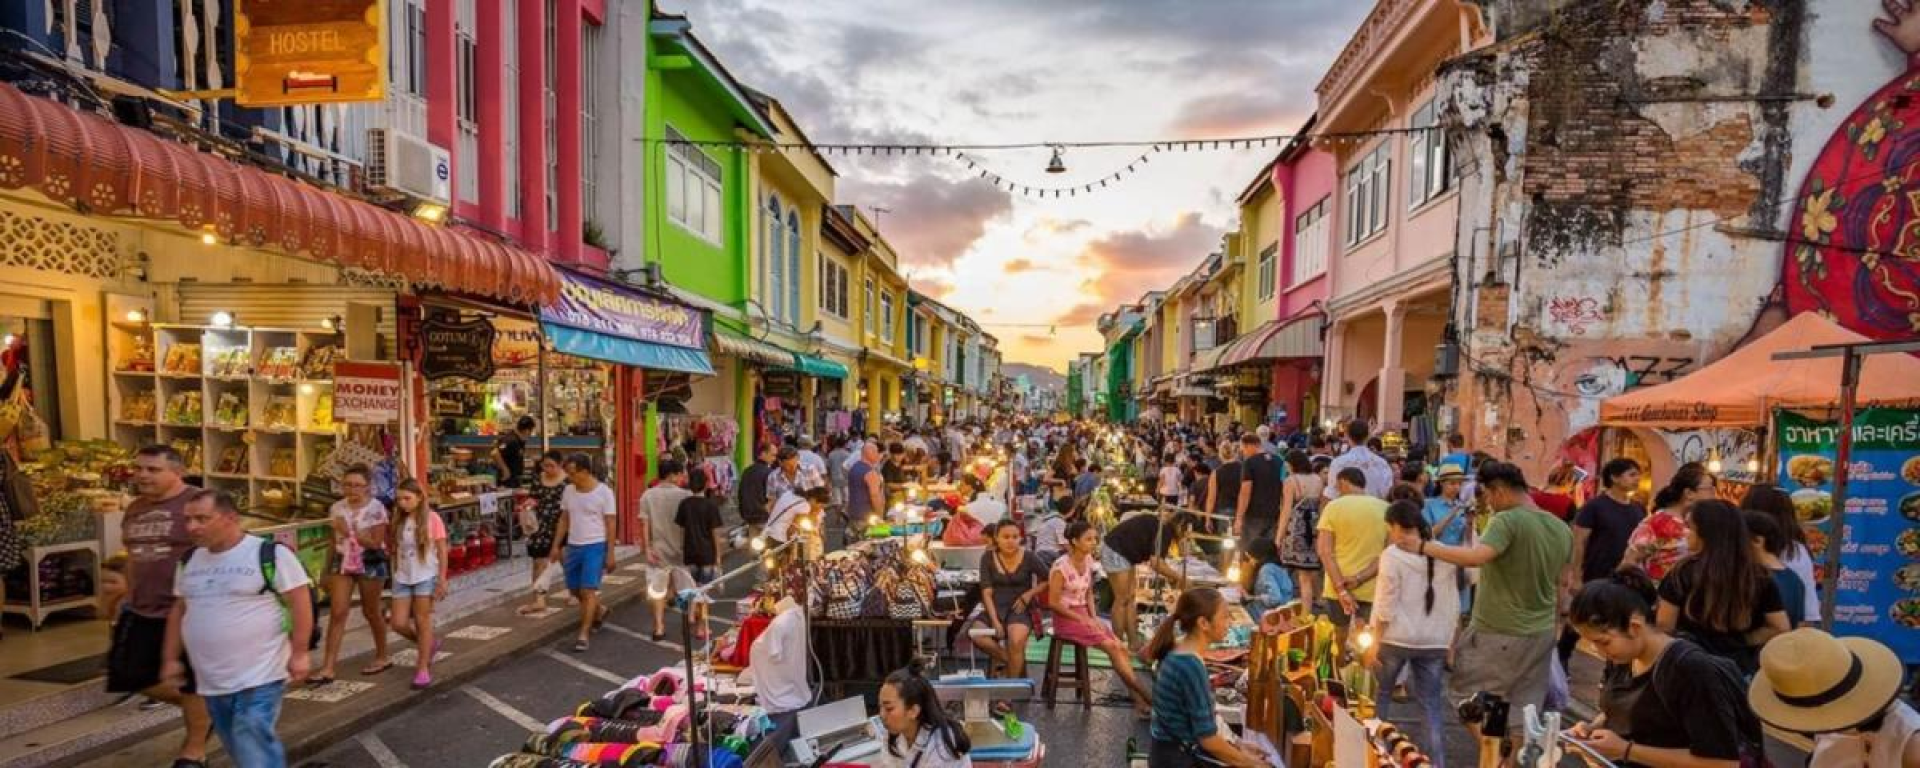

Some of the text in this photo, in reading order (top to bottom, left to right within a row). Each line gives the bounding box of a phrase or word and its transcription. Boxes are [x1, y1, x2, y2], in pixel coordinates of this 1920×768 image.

[270, 30, 346, 55] HOSTEL
[337, 383, 398, 396] MONEY
[335, 396, 398, 410] EXCHANGE
